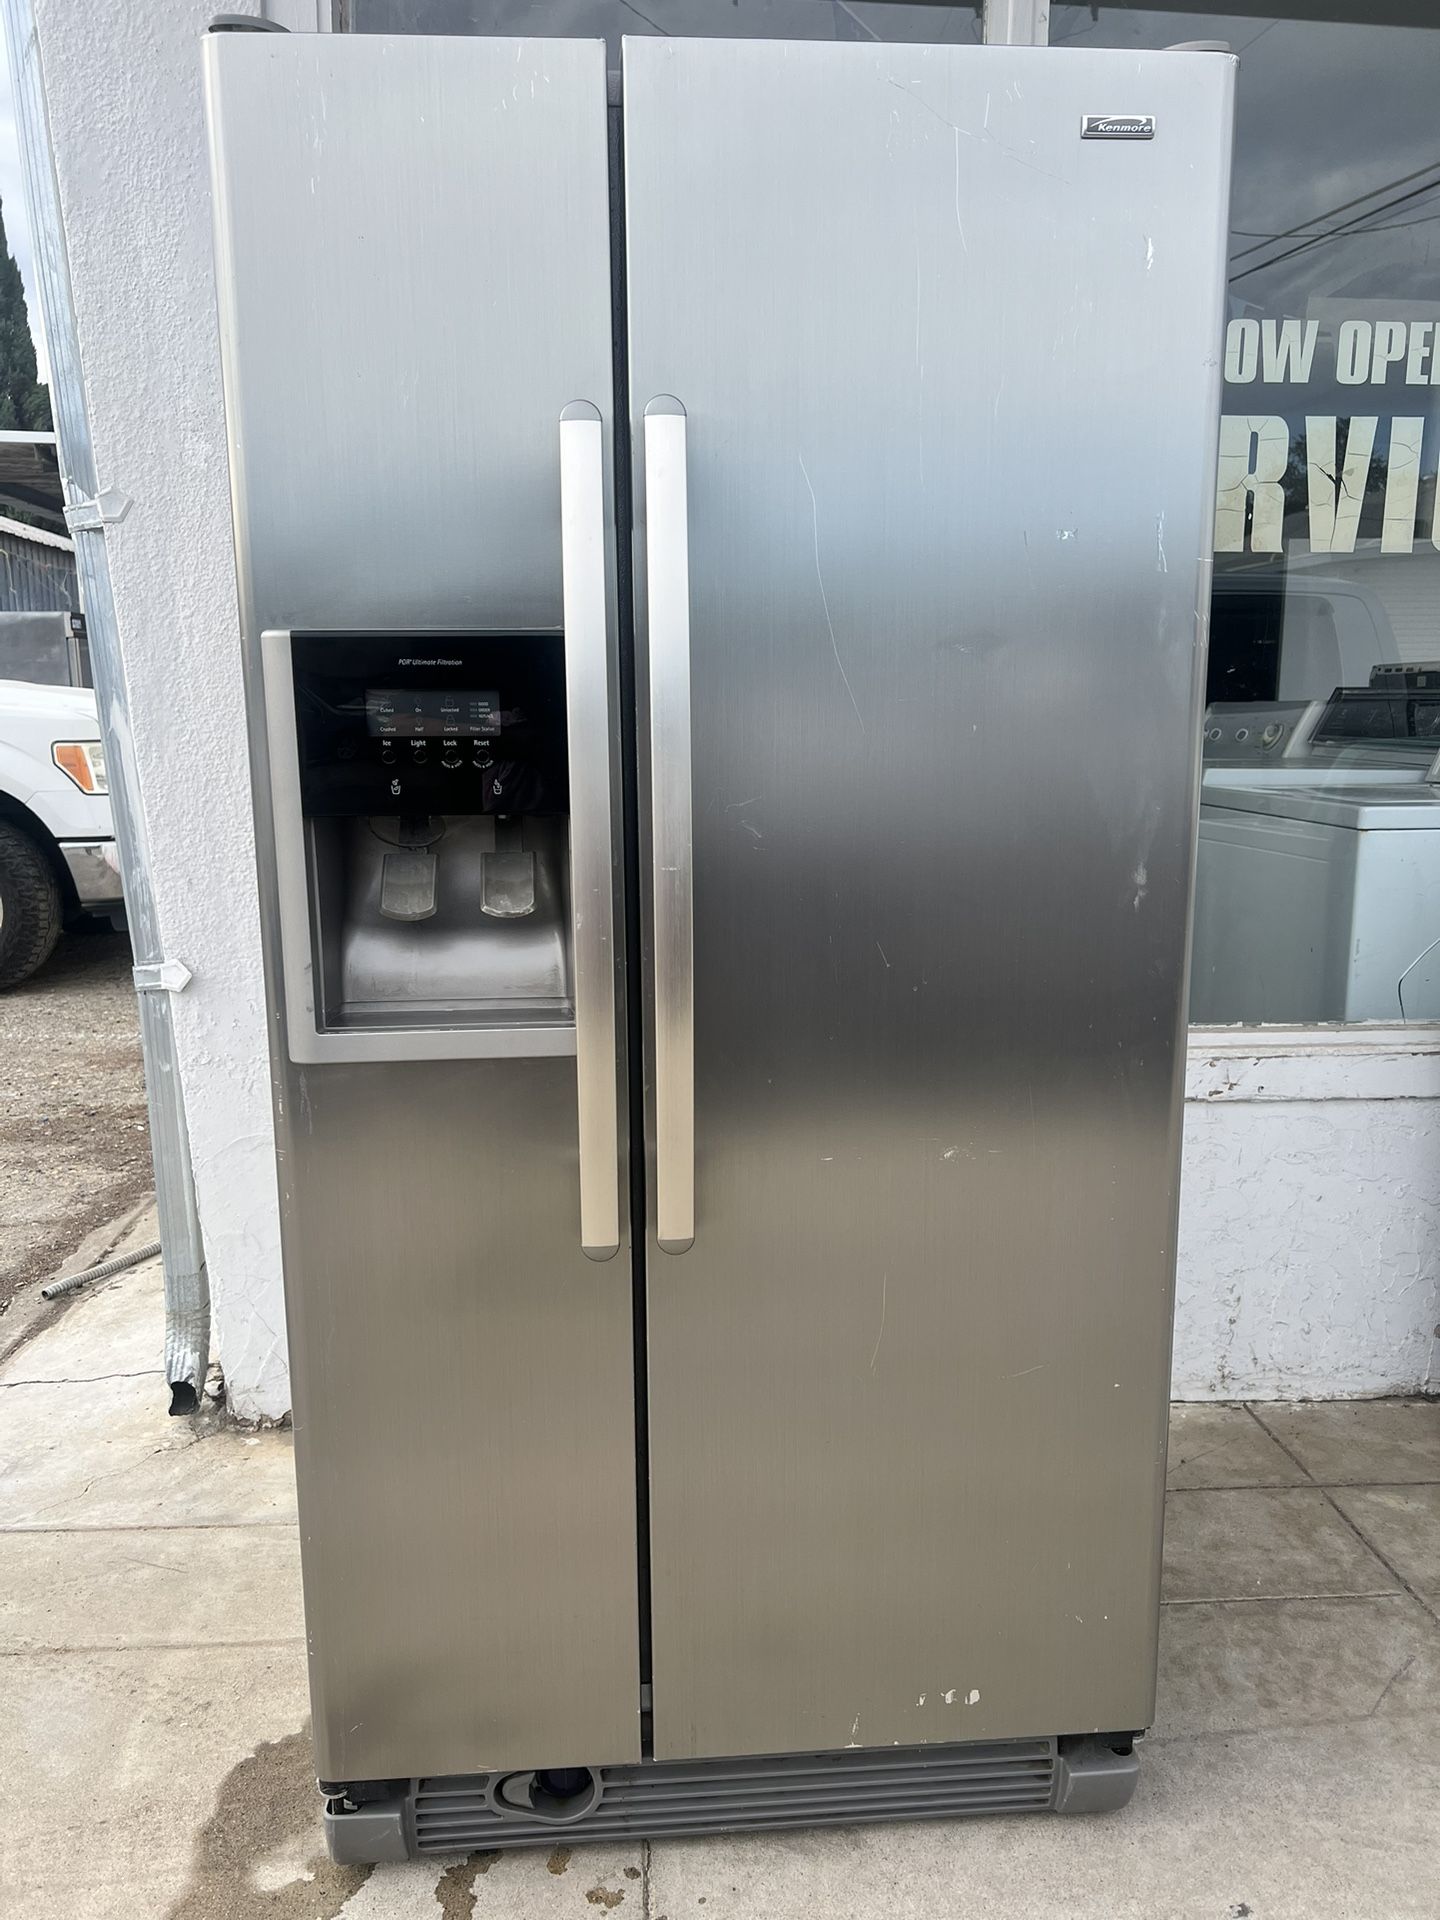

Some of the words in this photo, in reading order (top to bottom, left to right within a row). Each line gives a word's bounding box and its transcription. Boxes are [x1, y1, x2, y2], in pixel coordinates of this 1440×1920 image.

[1097, 123, 1152, 133] Kenmore
[1213, 415, 1440, 554] RVI
[412, 658, 436, 666] Ultimate
[437, 658, 462, 666] Filtration
[411, 740, 426, 748] Light
